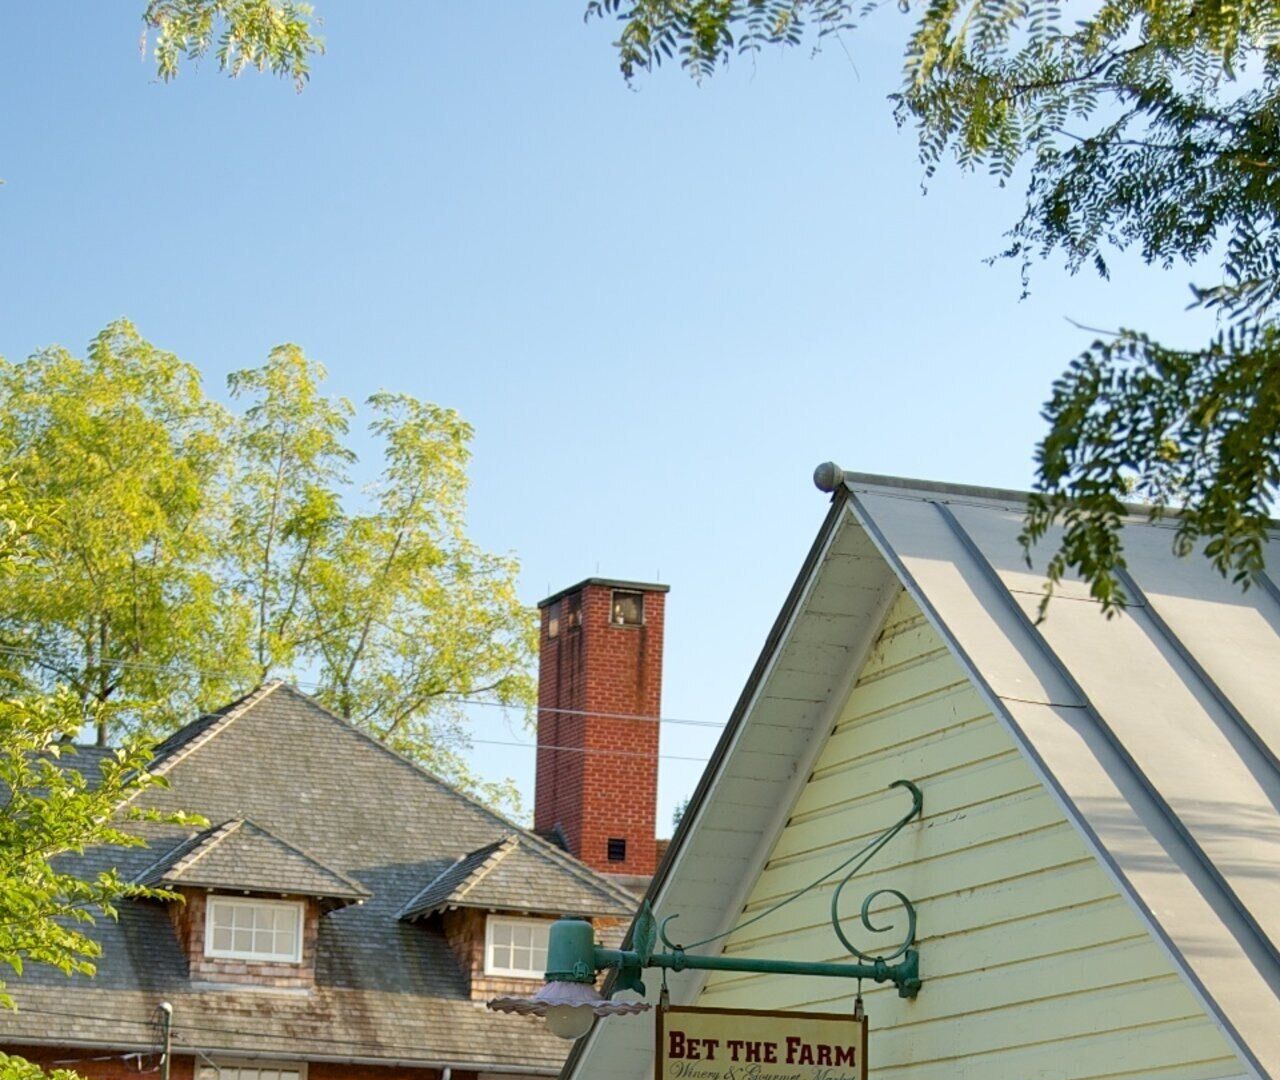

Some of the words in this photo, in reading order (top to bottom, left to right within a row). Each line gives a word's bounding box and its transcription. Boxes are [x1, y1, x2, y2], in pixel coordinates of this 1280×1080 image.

[668, 1030, 720, 1060] BET
[727, 1040, 778, 1064] THE
[786, 1036, 856, 1067] FARM
